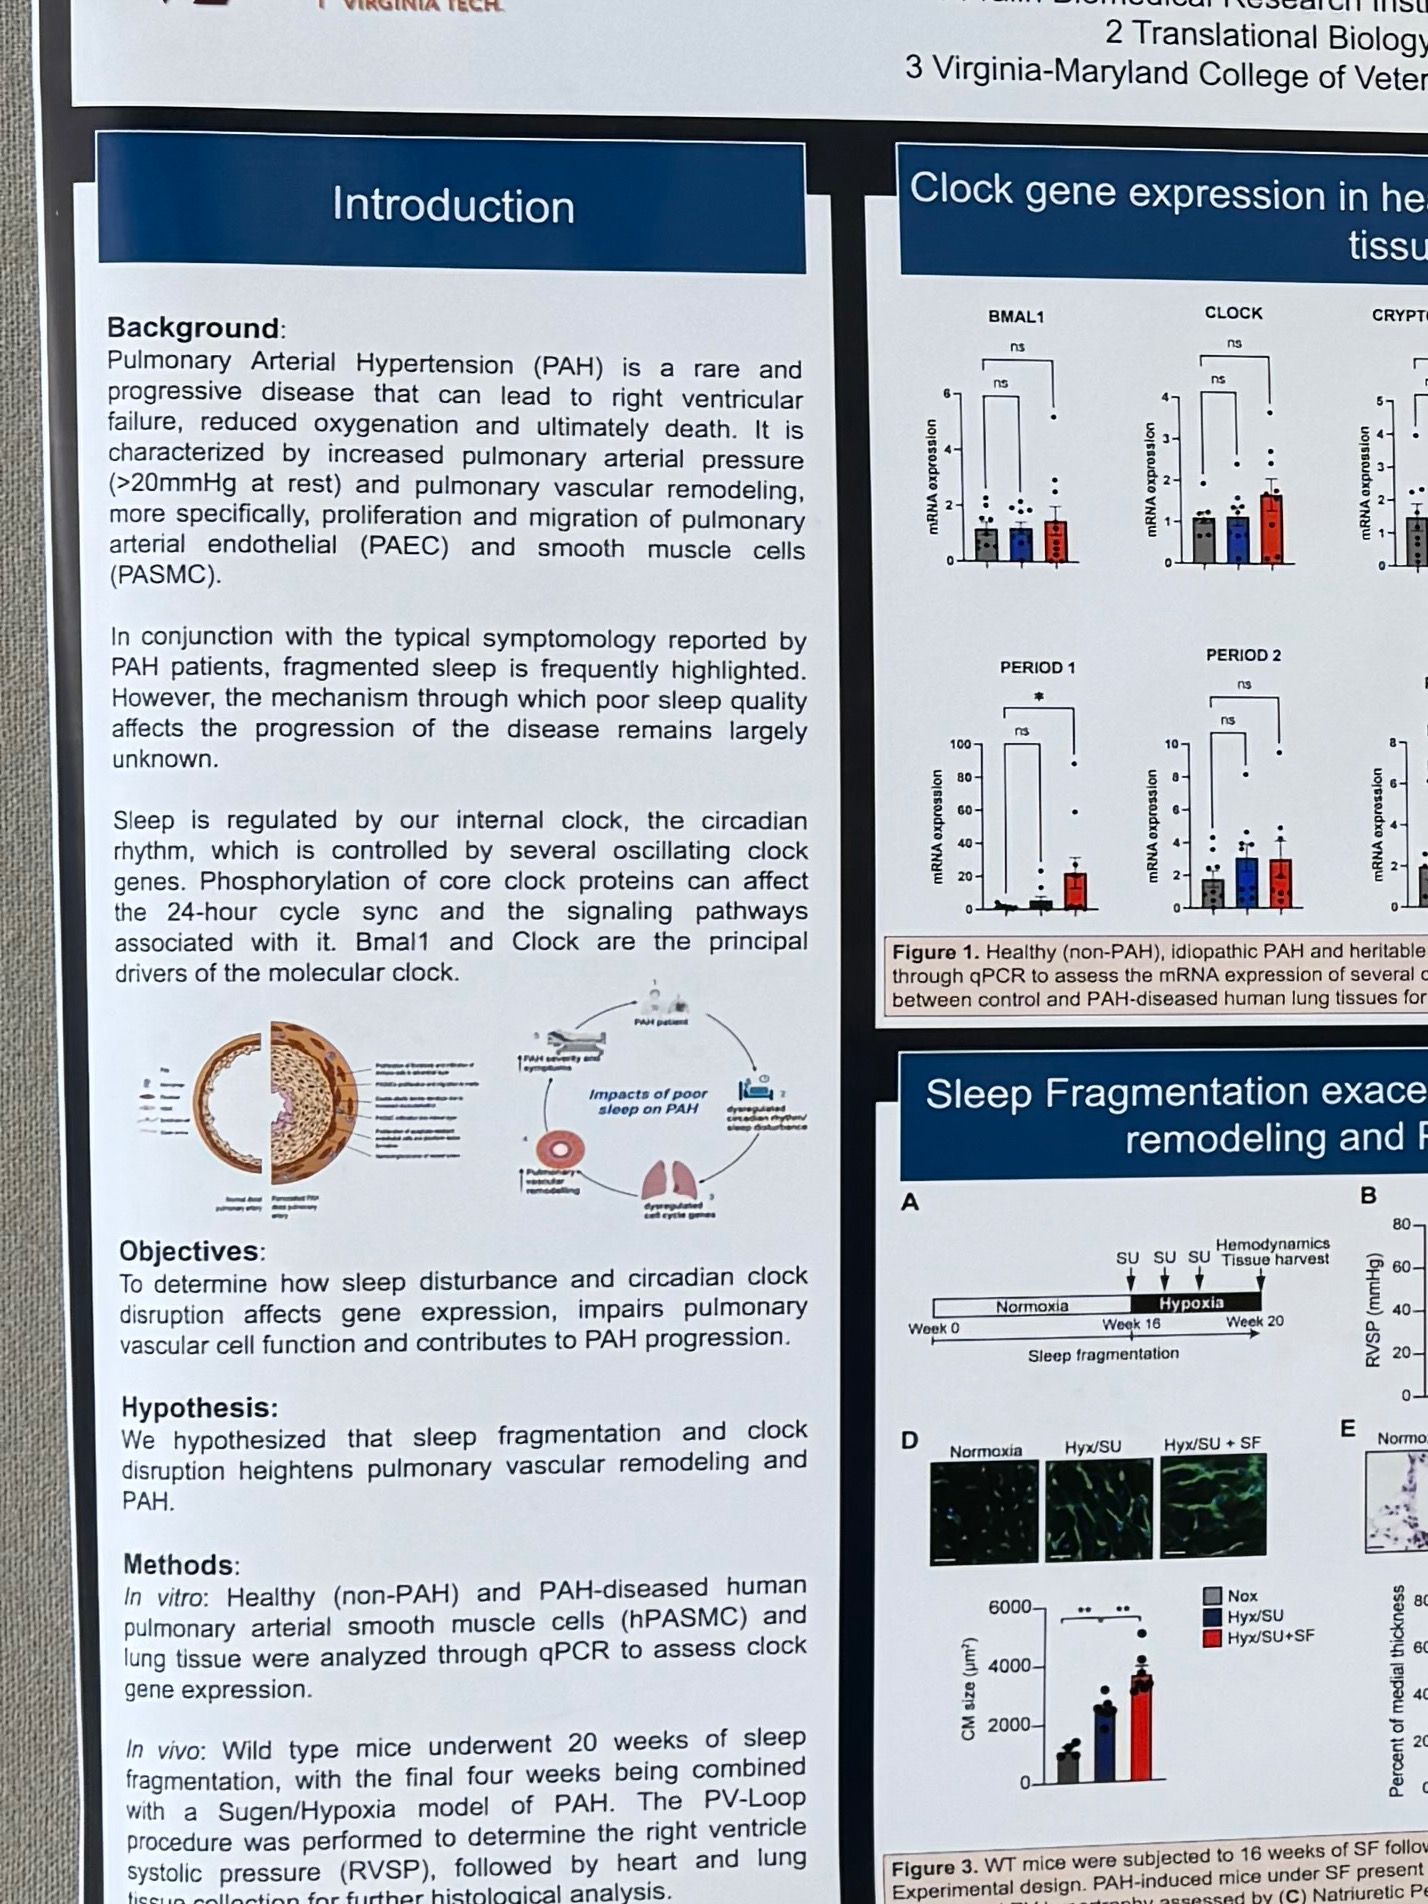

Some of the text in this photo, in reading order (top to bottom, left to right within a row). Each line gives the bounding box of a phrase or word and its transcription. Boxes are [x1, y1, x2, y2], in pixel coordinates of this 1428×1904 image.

[911, 171, 1014, 204] Clock
[1025, 181, 1117, 213] gene
[1129, 179, 1325, 216] expression
[1339, 180, 1368, 212] in
[334, 185, 574, 224] Introduction
[988, 309, 1044, 324] BMAL1
[1205, 305, 1263, 320] CLOCK
[108, 315, 286, 344] Background:
[108, 349, 802, 382] Pulmonary Arterial Hypertension (PAH) is a rare and
[1000, 660, 1075, 674] PERIOD 1
[949, 738, 973, 751] 100
[930, 841, 944, 885] mRNA
[588, 1088, 709, 1103] Impacts of poor
[926, 1078, 1032, 1116] Sleep
[1047, 1075, 1308, 1115] Fragmentation
[598, 1102, 700, 1117] sleep on PAH
[1127, 1122, 1326, 1160] remodeling
[1339, 1120, 1404, 1151] and
[900, 1192, 920, 1211] A
[1360, 1185, 1378, 1205] B
[1392, 1217, 1412, 1231] 80
[119, 1239, 266, 1268] Objectives:
[1216, 1238, 1331, 1254] Hemodynamics
[996, 1300, 1069, 1314] Normoxia
[1159, 1295, 1225, 1313] Hypoxia
[1365, 1252, 1385, 1368] RVSP (mmHg)
[1226, 1314, 1285, 1328] Week 20
[1028, 1346, 1180, 1365] Sleep fragmentation
[122, 1395, 278, 1424] Hypothesis:
[124, 1552, 240, 1576] Methods:
